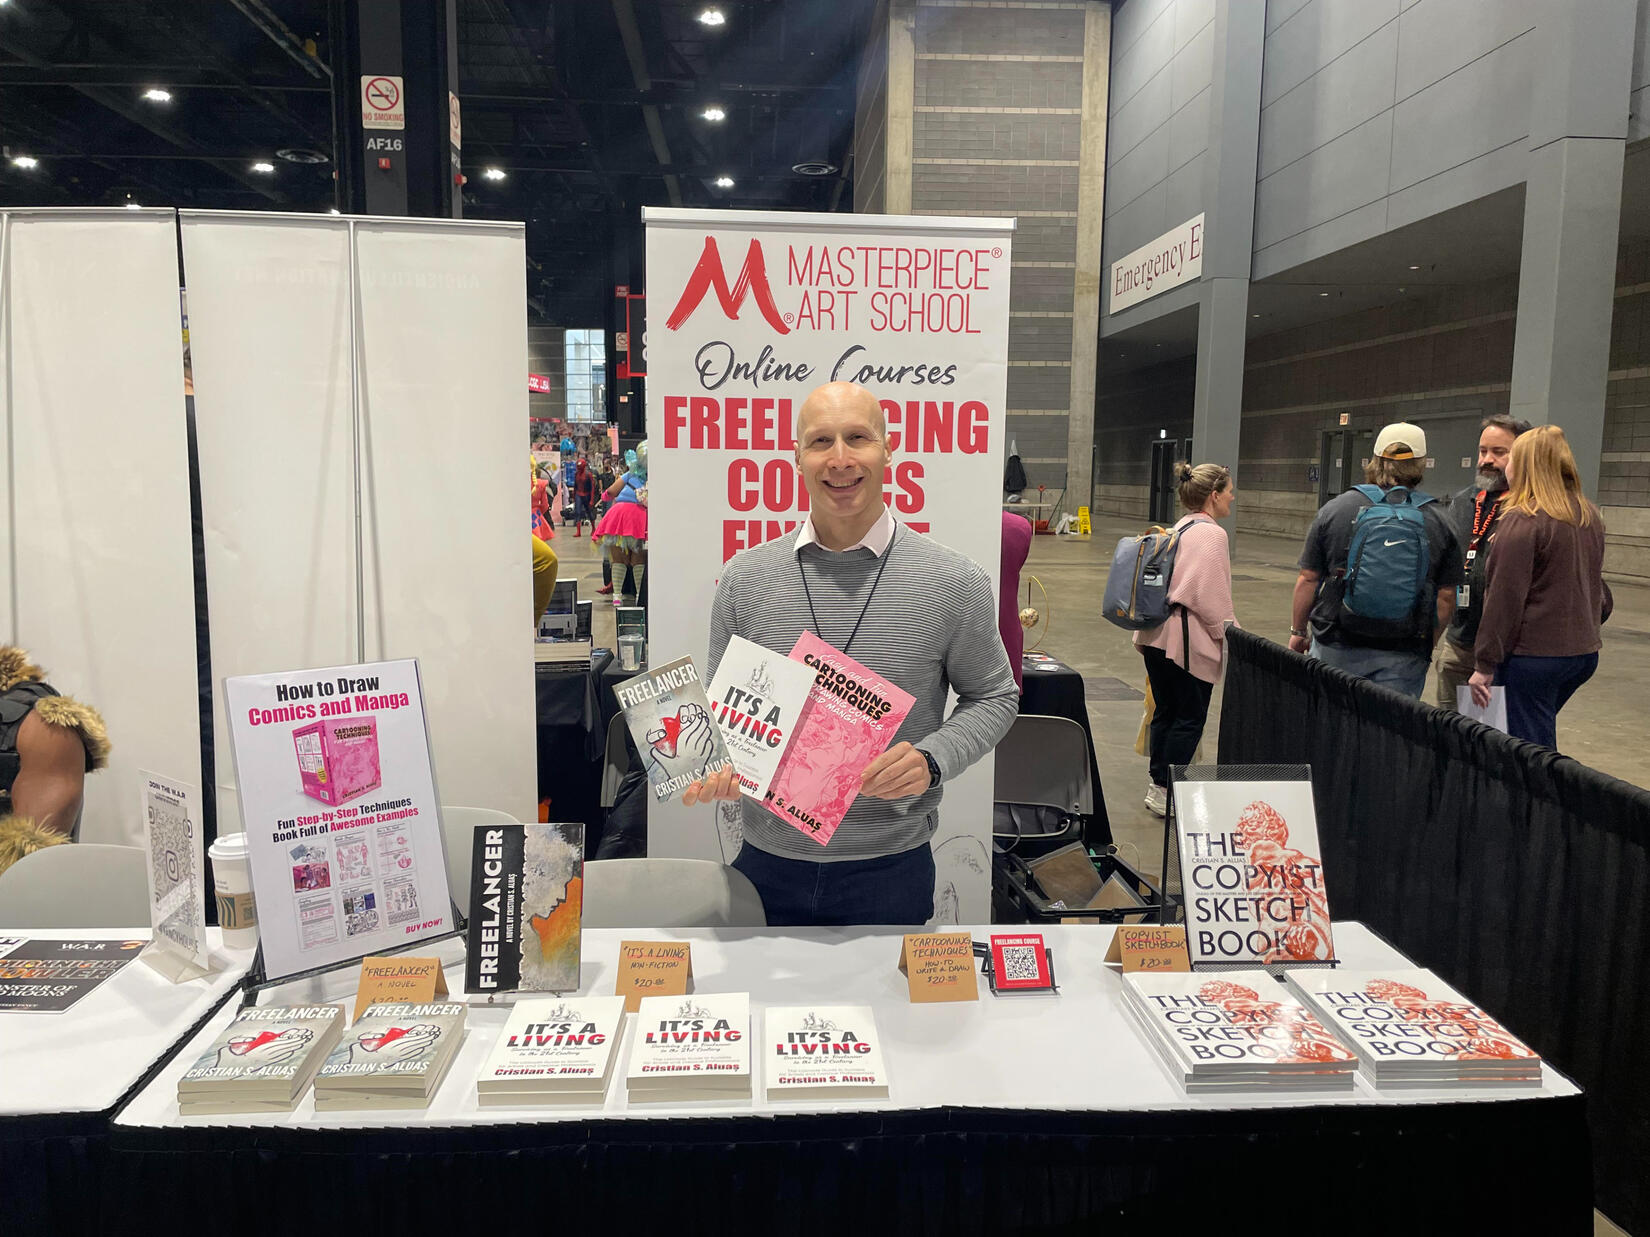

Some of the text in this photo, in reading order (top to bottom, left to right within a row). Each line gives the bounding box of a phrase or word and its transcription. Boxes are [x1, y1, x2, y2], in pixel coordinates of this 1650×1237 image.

[364, 112, 404, 122] NO SMOKING
[366, 138, 402, 151] AF16
[1115, 241, 1186, 296] Emergency
[796, 291, 981, 334] ART SCHOOL
[694, 341, 817, 391] Online
[831, 345, 957, 386] Courses
[664, 396, 989, 454] FREELCING
[804, 654, 892, 712] CARTOONING
[820, 654, 888, 697] Easy and Fun
[276, 676, 380, 702] How to Draw
[618, 663, 698, 709] FREELANCER
[816, 674, 884, 720] CHNIQUES
[248, 692, 410, 726] Comics and Manga
[724, 686, 780, 726] IT'S A
[826, 703, 858, 726] MANGA
[848, 706, 884, 731] COMICS
[655, 772, 695, 798] CRISTIAN
[775, 794, 785, 808] S.
[277, 818, 295, 830] Fun
[296, 806, 358, 828] Step-by-Step
[359, 798, 412, 816] Techniques
[272, 830, 298, 844] Book
[299, 826, 318, 838] Full
[318, 822, 330, 835] of
[330, 814, 376, 832] Awesome
[376, 807, 420, 825] Examples
[1186, 832, 1246, 857] THE
[1192, 864, 1320, 890] COPYIST
[480, 829, 504, 989] FREELANCER
[1196, 898, 1312, 922] SKETCH
[406, 918, 443, 934] BUY NOW!
[1199, 930, 1294, 956] BOOK
[648, 948, 654, 957] A
[925, 960, 954, 968] HOW-TO
[1148, 996, 1218, 1008] THE
[1315, 992, 1388, 1004] THE
[237, 1007, 340, 1022] FREELANCER
[363, 1004, 462, 1018] FREELANCER
[1165, 1009, 1308, 1024] COPYIT
[1336, 1006, 1483, 1020] COPYIST
[524, 1022, 596, 1034] IT'S A
[660, 1020, 730, 1032] IT'S A
[1352, 1024, 1494, 1038] SKETCH
[506, 1034, 606, 1048] LIVING
[646, 1030, 742, 1044] LIVING
[787, 1032, 858, 1043] IT'S A
[776, 1042, 872, 1056] LIVING
[1368, 1040, 1475, 1056] BOOK
[186, 1067, 242, 1078] CRISTIAN
[242, 1066, 258, 1076] S.
[322, 1063, 378, 1074] CRISTIAN
[378, 1062, 390, 1073] S.
